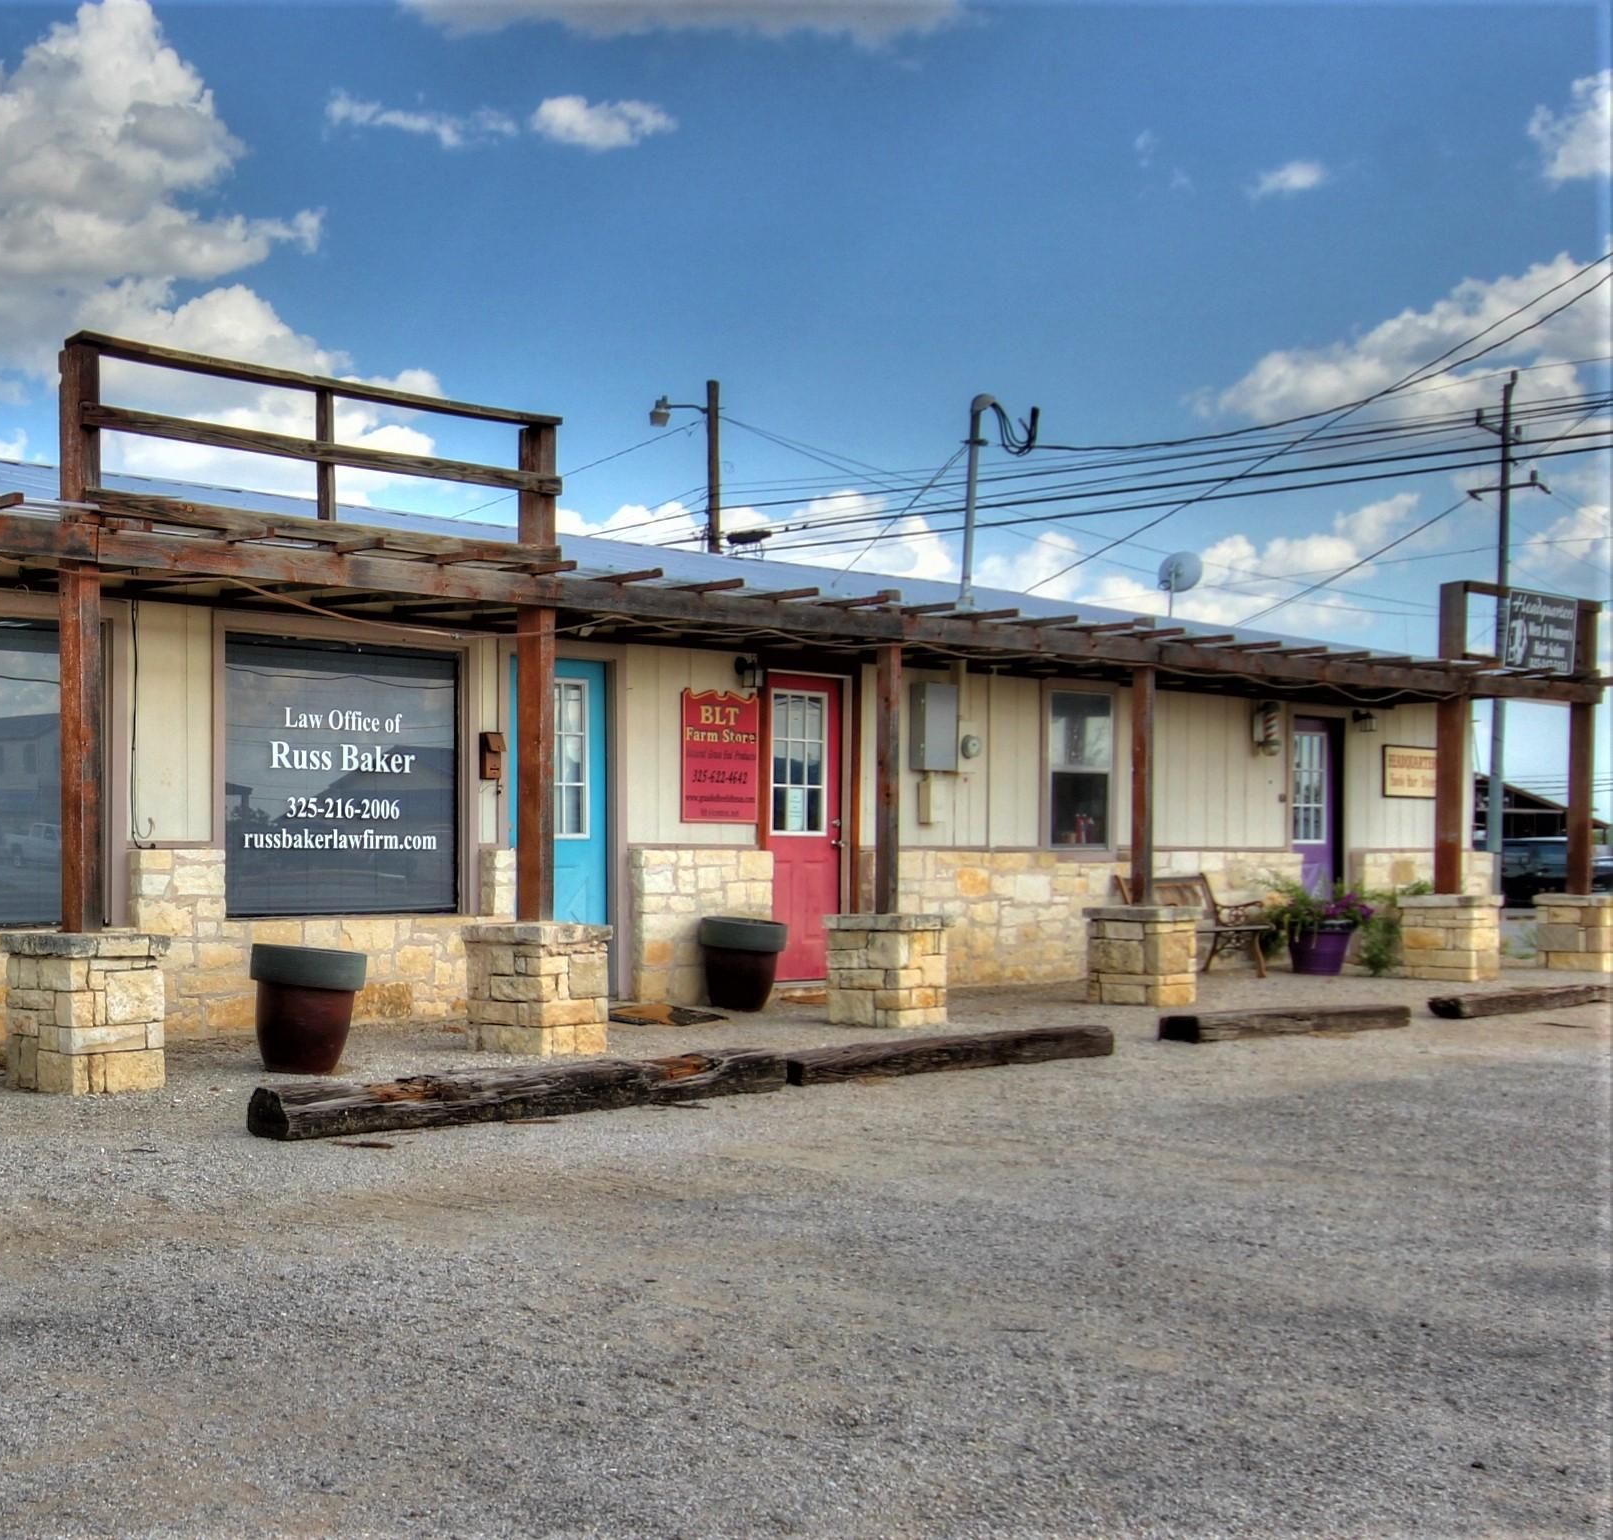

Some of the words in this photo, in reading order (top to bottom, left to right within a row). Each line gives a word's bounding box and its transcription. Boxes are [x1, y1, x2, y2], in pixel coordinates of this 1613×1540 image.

[284, 706, 324, 729] Law
[328, 709, 380, 732] Office
[385, 713, 403, 734] of
[700, 705, 740, 726] BLT
[686, 726, 719, 743] Farm
[722, 728, 755, 744] Store
[269, 740, 332, 771] Russ
[340, 743, 416, 774] Baker
[691, 768, 748, 785] 325-622-4642
[286, 797, 401, 820] 325-216-2006
[243, 828, 437, 850] russbakerlawfirm.com
